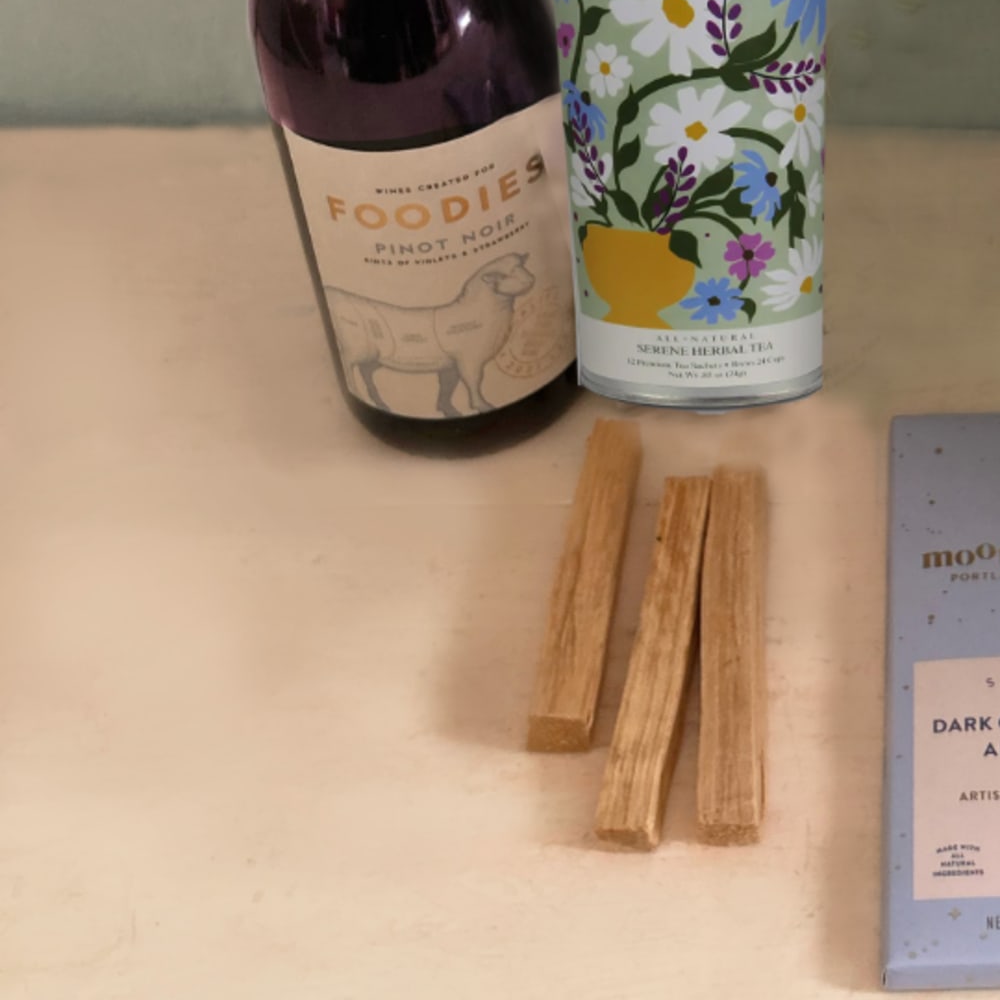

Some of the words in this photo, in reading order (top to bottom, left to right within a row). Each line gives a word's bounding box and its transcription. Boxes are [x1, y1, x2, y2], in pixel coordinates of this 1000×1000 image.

[417, 174, 470, 192] CREATED
[474, 162, 496, 177] FOR
[327, 152, 546, 231] FOODIES
[375, 238, 449, 255] PINOT
[462, 213, 516, 244] NOIR
[472, 221, 530, 254] STRAWBERRY
[637, 344, 690, 356] SERENE
[691, 345, 747, 357] HERBAL
[750, 341, 774, 353] TEA
[932, 715, 992, 733] DARK
[936, 843, 958, 853] MADE
[960, 843, 981, 852] WITH
[940, 858, 976, 867] NATURAL
[932, 868, 984, 877] INGREDIENTS
